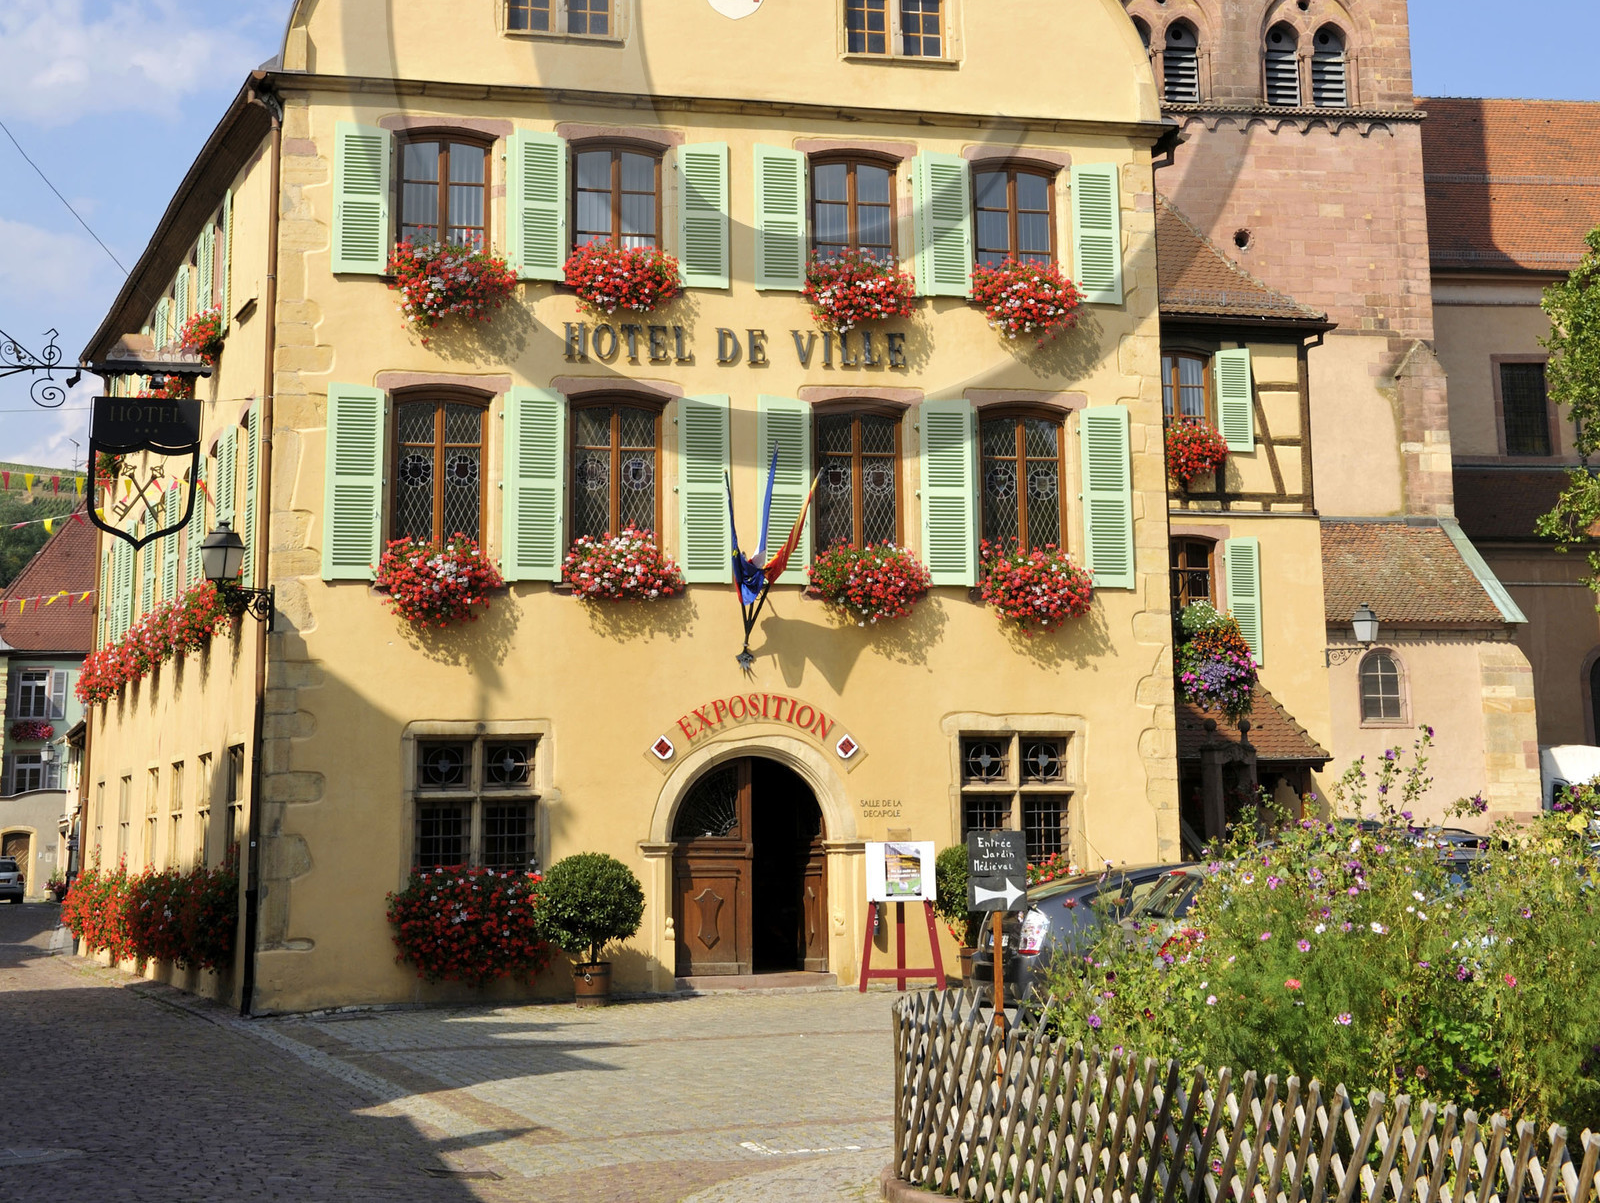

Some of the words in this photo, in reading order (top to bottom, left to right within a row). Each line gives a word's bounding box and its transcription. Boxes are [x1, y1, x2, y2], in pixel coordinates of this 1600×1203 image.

[563, 322, 693, 363] HOTEL
[716, 328, 768, 364] DE
[790, 330, 908, 368] VILLE
[109, 401, 187, 424] HÔTEL
[676, 693, 836, 741] EXPOSITION
[860, 799, 880, 808] SALLE
[882, 799, 892, 808] DE
[893, 799, 902, 808] LA
[977, 837, 1012, 848] Entrée
[982, 848, 1015, 859] Jardin
[973, 859, 1013, 872] Médiéval
